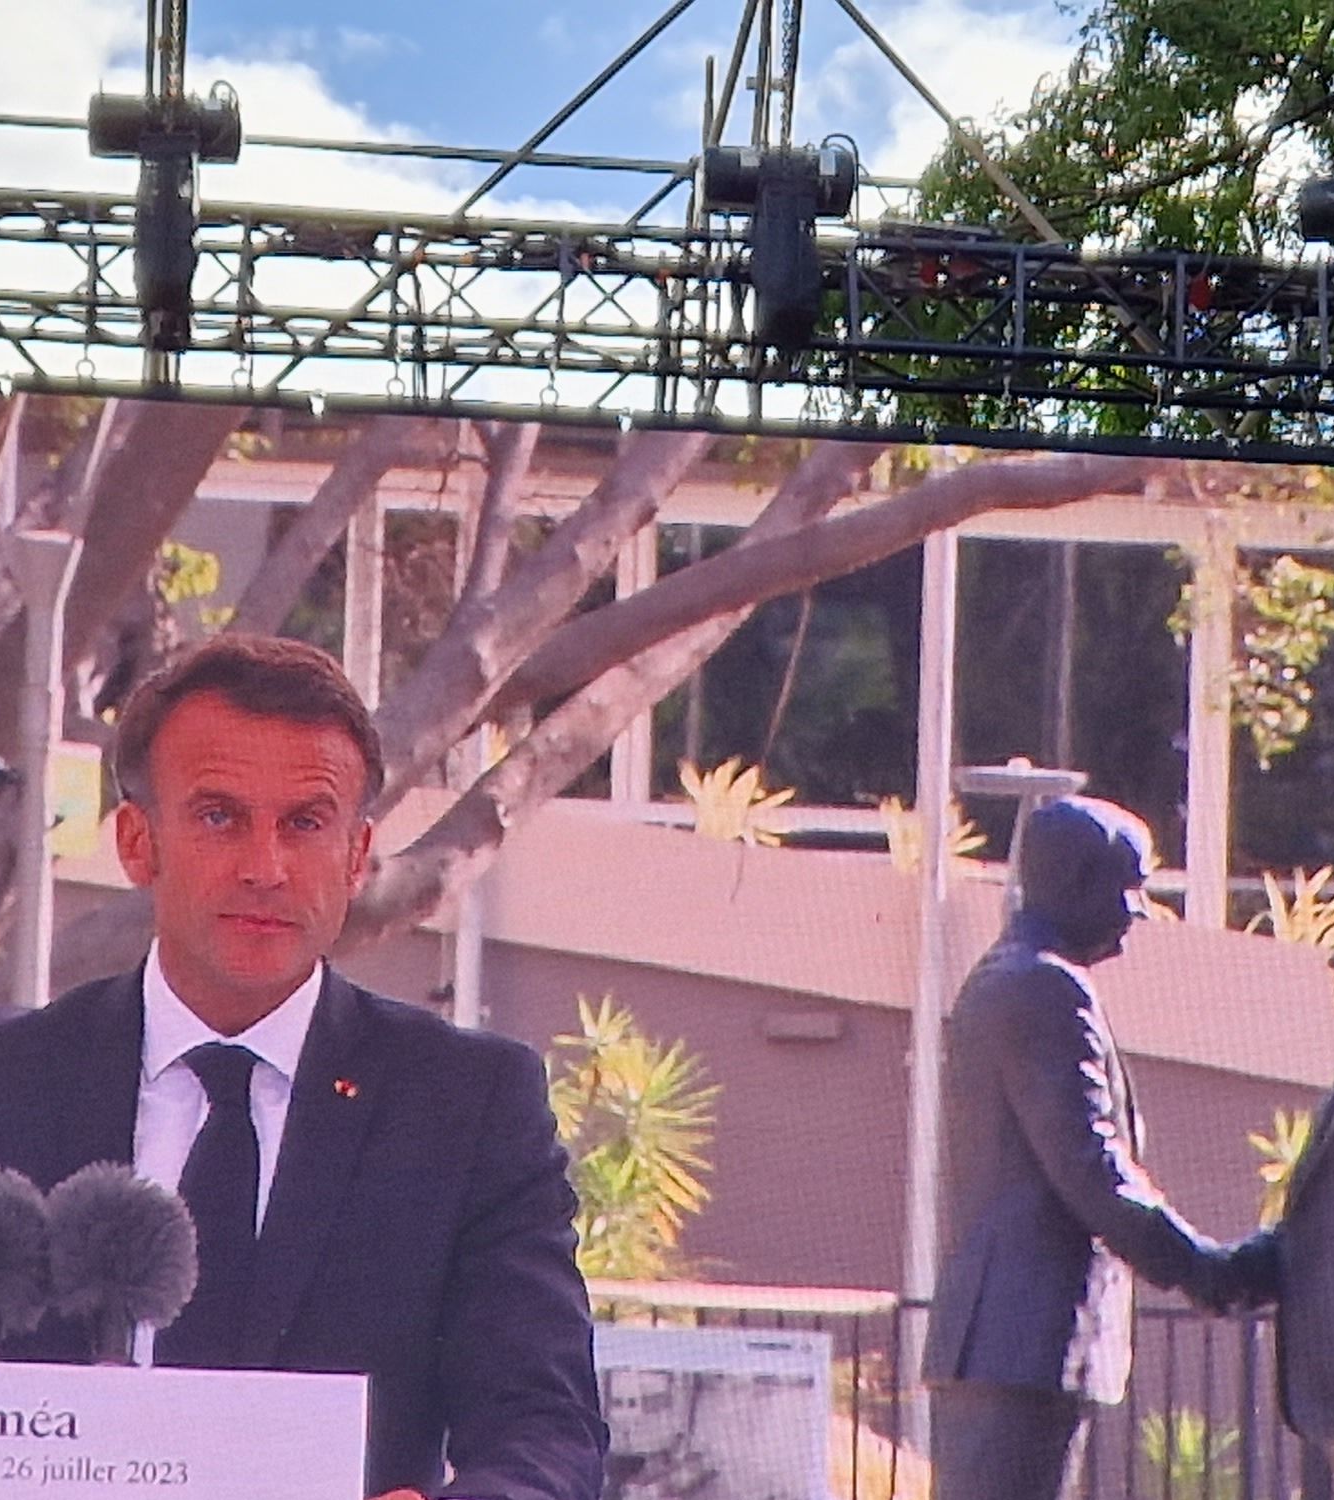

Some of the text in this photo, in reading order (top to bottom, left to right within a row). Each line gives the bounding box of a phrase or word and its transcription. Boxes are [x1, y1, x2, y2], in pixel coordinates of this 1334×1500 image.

[1, 1456, 33, 1480] 26
[40, 1455, 117, 1486] juillet
[126, 1460, 189, 1486] 2023
